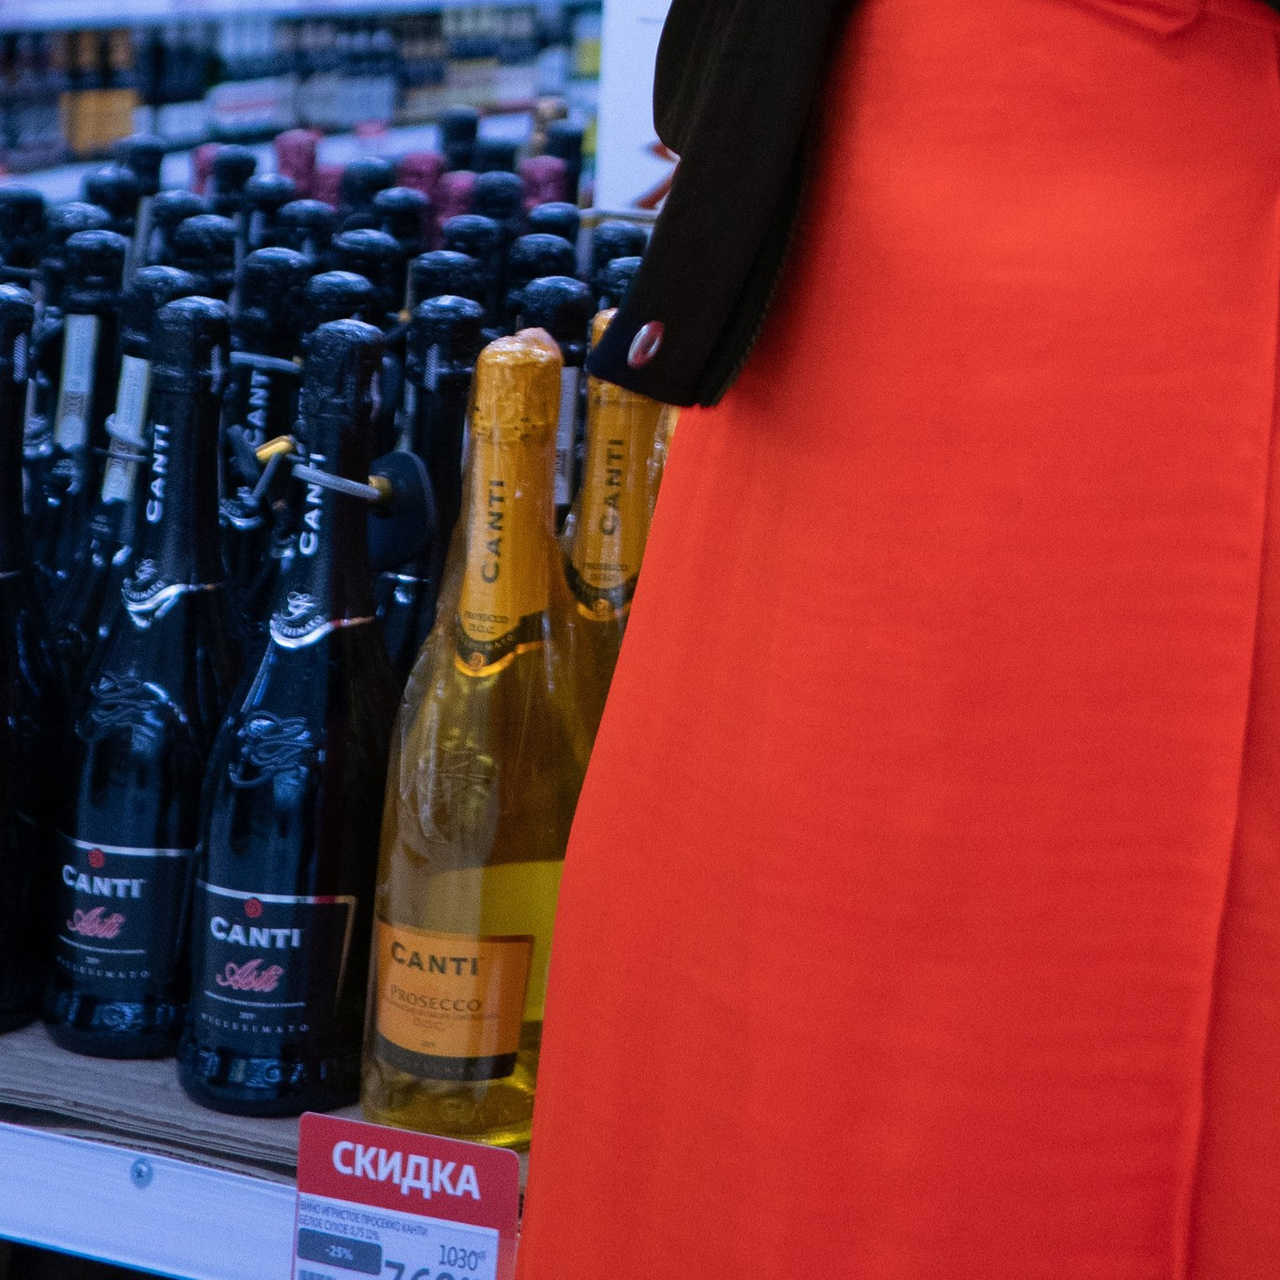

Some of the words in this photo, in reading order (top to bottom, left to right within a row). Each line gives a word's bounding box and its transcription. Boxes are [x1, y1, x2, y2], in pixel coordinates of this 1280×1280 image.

[242, 370, 270, 447] CANT
[146, 424, 169, 523] CANTI
[600, 439, 624, 535] CANTI
[481, 479, 506, 584] CANTI
[62, 864, 141, 898] CANTI
[210, 915, 300, 949] CANTI
[391, 941, 479, 976] CANTI
[391, 984, 481, 1012] PROSECCO
[332, 1140, 481, 1200] СКИДКА
[325, 1244, 354, 1261] -25%
[438, 1244, 478, 1271] 1030
